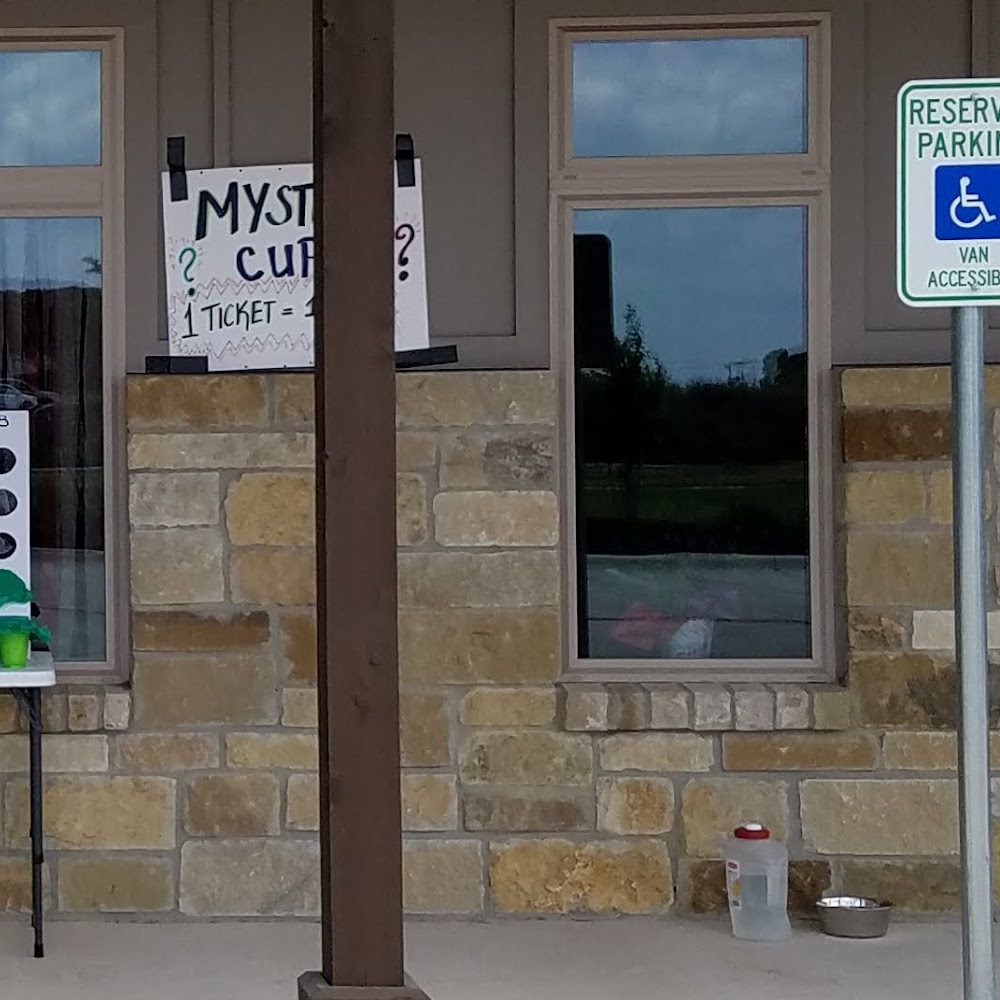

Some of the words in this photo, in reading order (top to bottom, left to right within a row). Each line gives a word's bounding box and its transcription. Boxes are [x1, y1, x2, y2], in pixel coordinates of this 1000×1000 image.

[909, 96, 1000, 125] RESERV
[918, 130, 1000, 158] PARKI
[195, 181, 314, 241] MYST
[236, 236, 314, 281] CUP
[959, 246, 989, 263] VAN
[928, 269, 1000, 288] ACCESSIB
[181, 302, 199, 339] 1
[201, 300, 277, 332] TICKET
